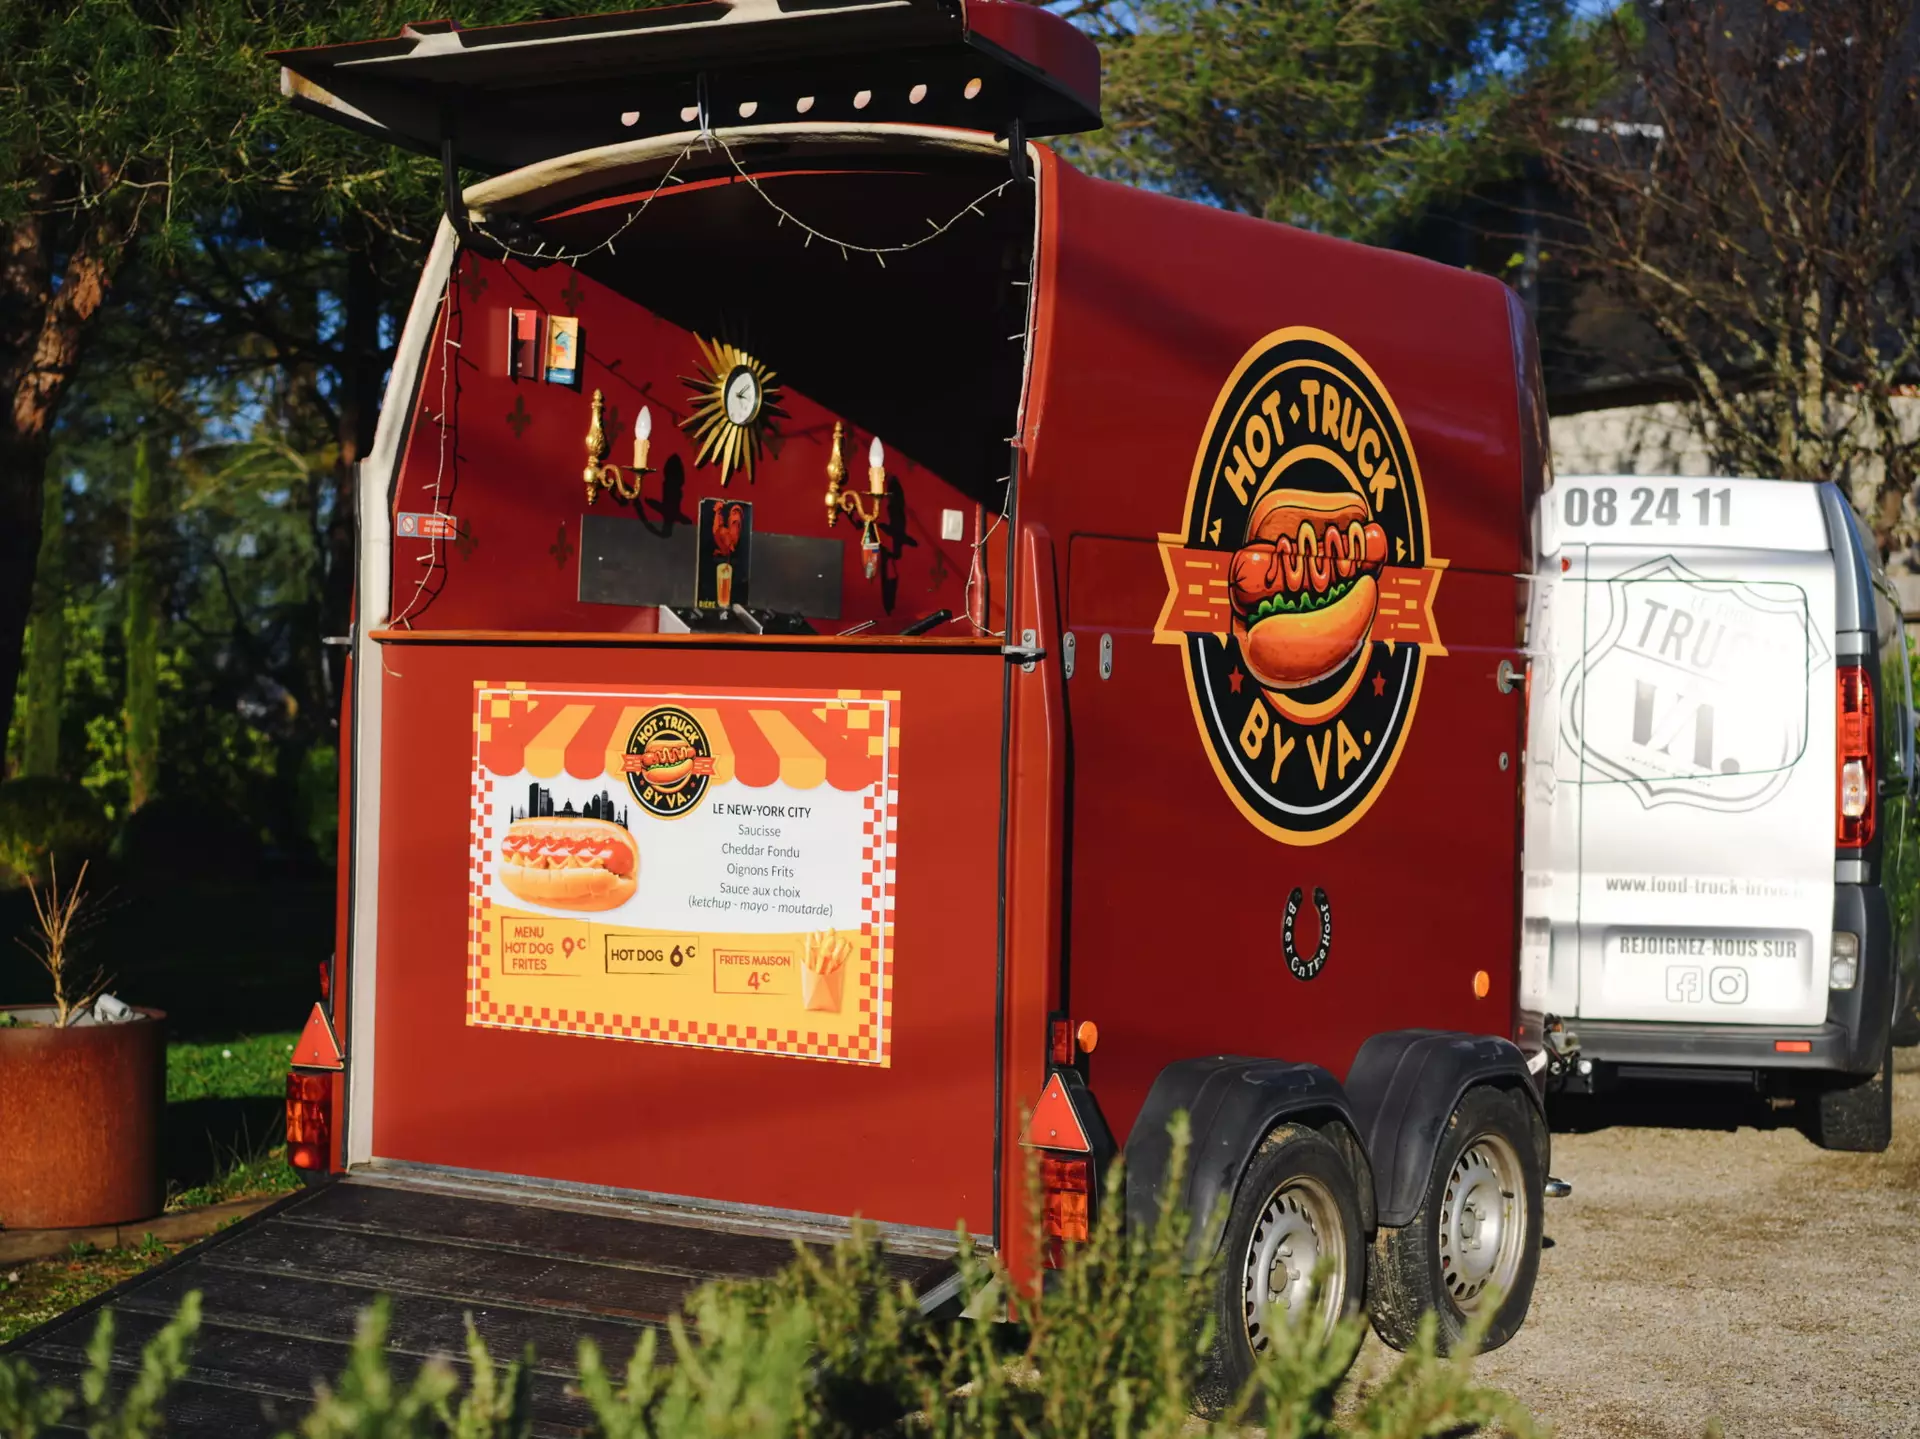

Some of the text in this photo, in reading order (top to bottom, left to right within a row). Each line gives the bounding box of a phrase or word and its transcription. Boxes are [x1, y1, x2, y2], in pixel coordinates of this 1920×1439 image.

[1224, 378, 1397, 512] HOT TRUCK
[1564, 487, 1731, 527] 08 24 11
[637, 715, 699, 745] HOT TRUCK
[1239, 698, 1295, 784] BY
[643, 786, 663, 806] BY
[712, 803, 812, 819] LE NEW-YORK CITY
[738, 824, 781, 838] Saucisse
[721, 842, 800, 859] Cheddar Fondu
[726, 863, 794, 878] Oignons Frits
[720, 882, 801, 898] Sauce aux choix
[688, 895, 731, 911] (ketchup
[740, 901, 769, 914] mayo
[778, 903, 833, 918] moutarde)
[514, 926, 544, 939] MENU
[505, 942, 527, 954] HOT
[529, 943, 554, 955] DOG
[1619, 935, 1797, 958] REJOIGNEZ-NOUS SUR
[611, 948, 635, 961] HOT
[637, 949, 664, 962] DOG
[719, 955, 791, 967] FRITES MAISON
[512, 958, 547, 970] FRITES
